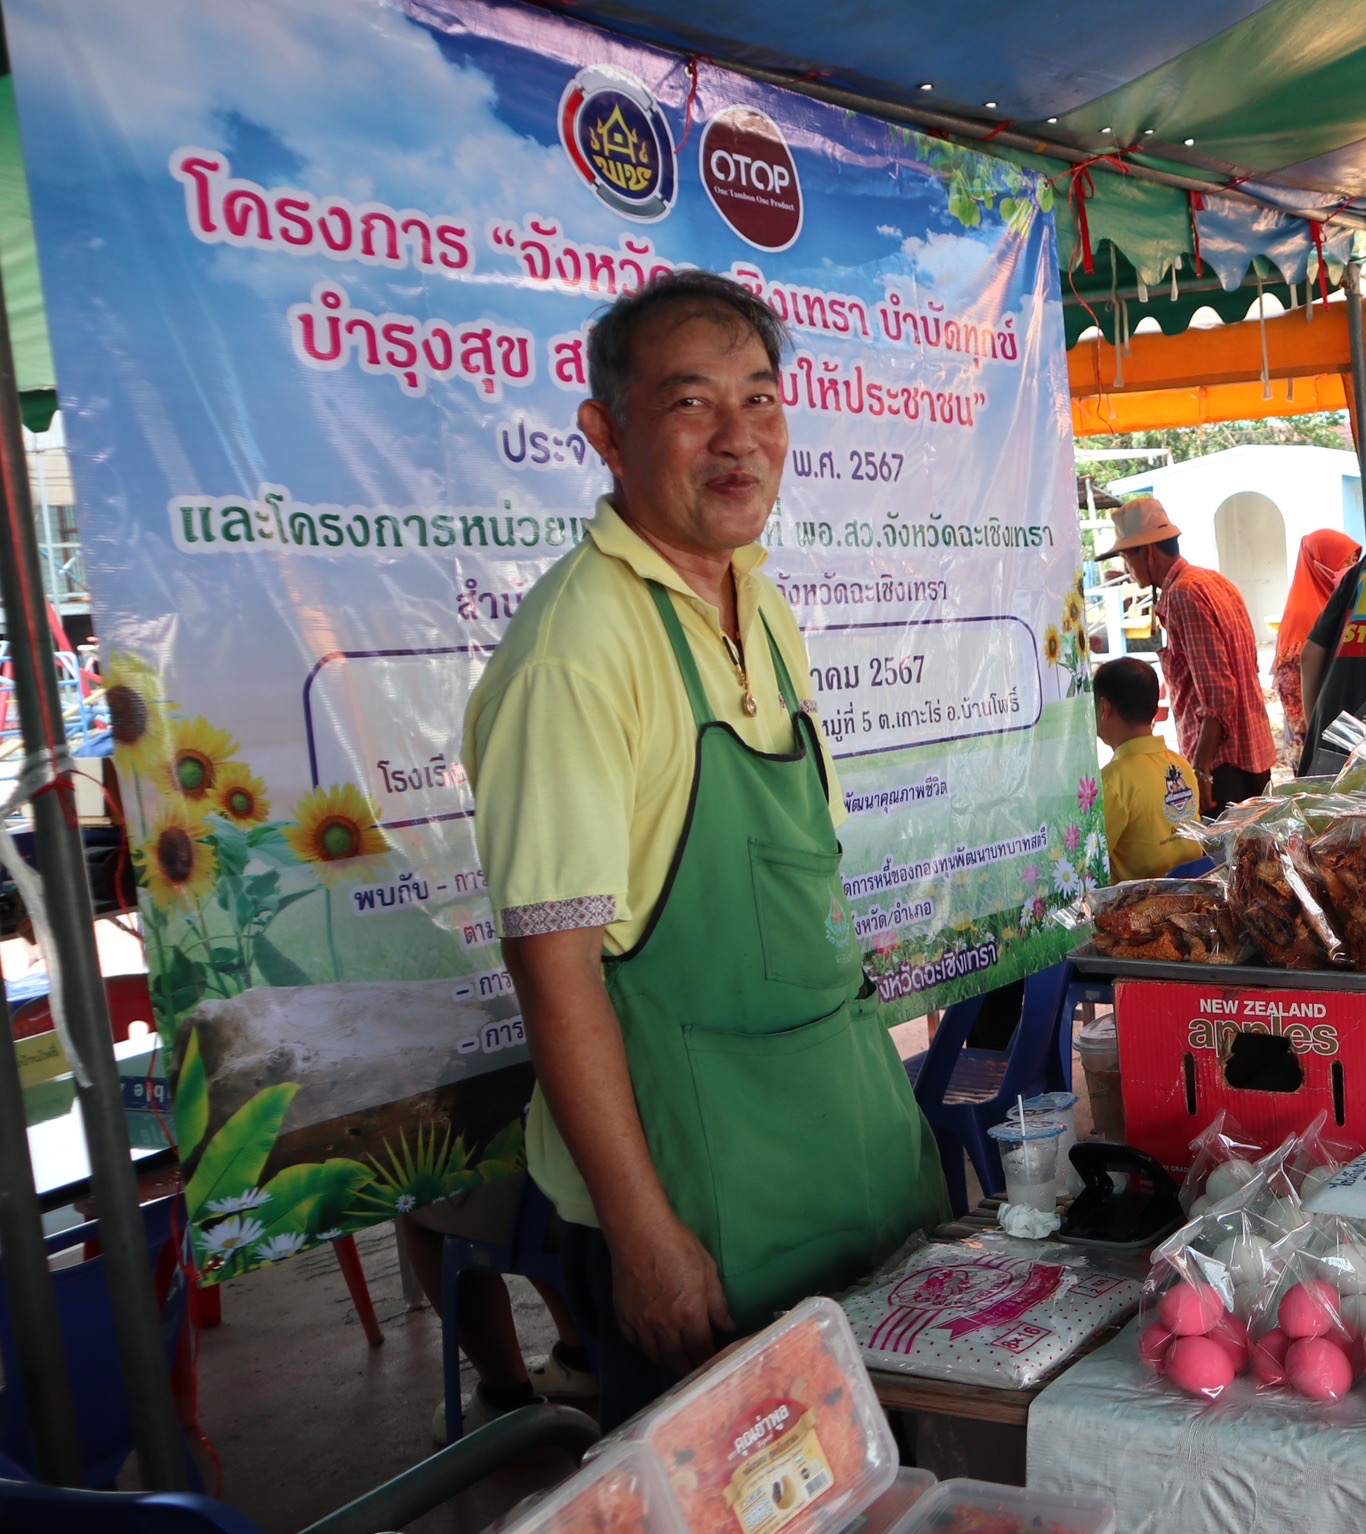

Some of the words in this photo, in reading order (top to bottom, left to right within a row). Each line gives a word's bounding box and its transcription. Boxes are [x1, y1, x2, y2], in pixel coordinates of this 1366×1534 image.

[710, 149, 790, 195] OTOP
[713, 186, 729, 196] One
[728, 188, 756, 202] Tambon
[756, 195, 770, 205] One
[769, 198, 795, 211] Product
[180, 157, 470, 270] โครงการ
[880, 293, 1018, 369] บำบัดทุกข์
[298, 291, 529, 395] บำรุงสุข
[792, 450, 842, 480] พ.ศ.
[849, 450, 904, 482] 2567
[809, 664, 860, 692] าคม
[869, 655, 925, 688] 2567
[862, 711, 873, 733] 5
[879, 699, 942, 730] ต.เกาะไร่
[947, 685, 1020, 722] อ.บ้านโพธิ์
[353, 872, 429, 911] พบกับ
[479, 969, 514, 996] การ
[841, 826, 1047, 897] ดการหนี้ของกองทุนพัฒนาบทบาทสตรี
[485, 1020, 525, 1048] การ
[852, 901, 932, 936] งหวัด/อำเภอ
[1200, 998, 1239, 1014] NEW
[1243, 1000, 1327, 1018] ZEALAND
